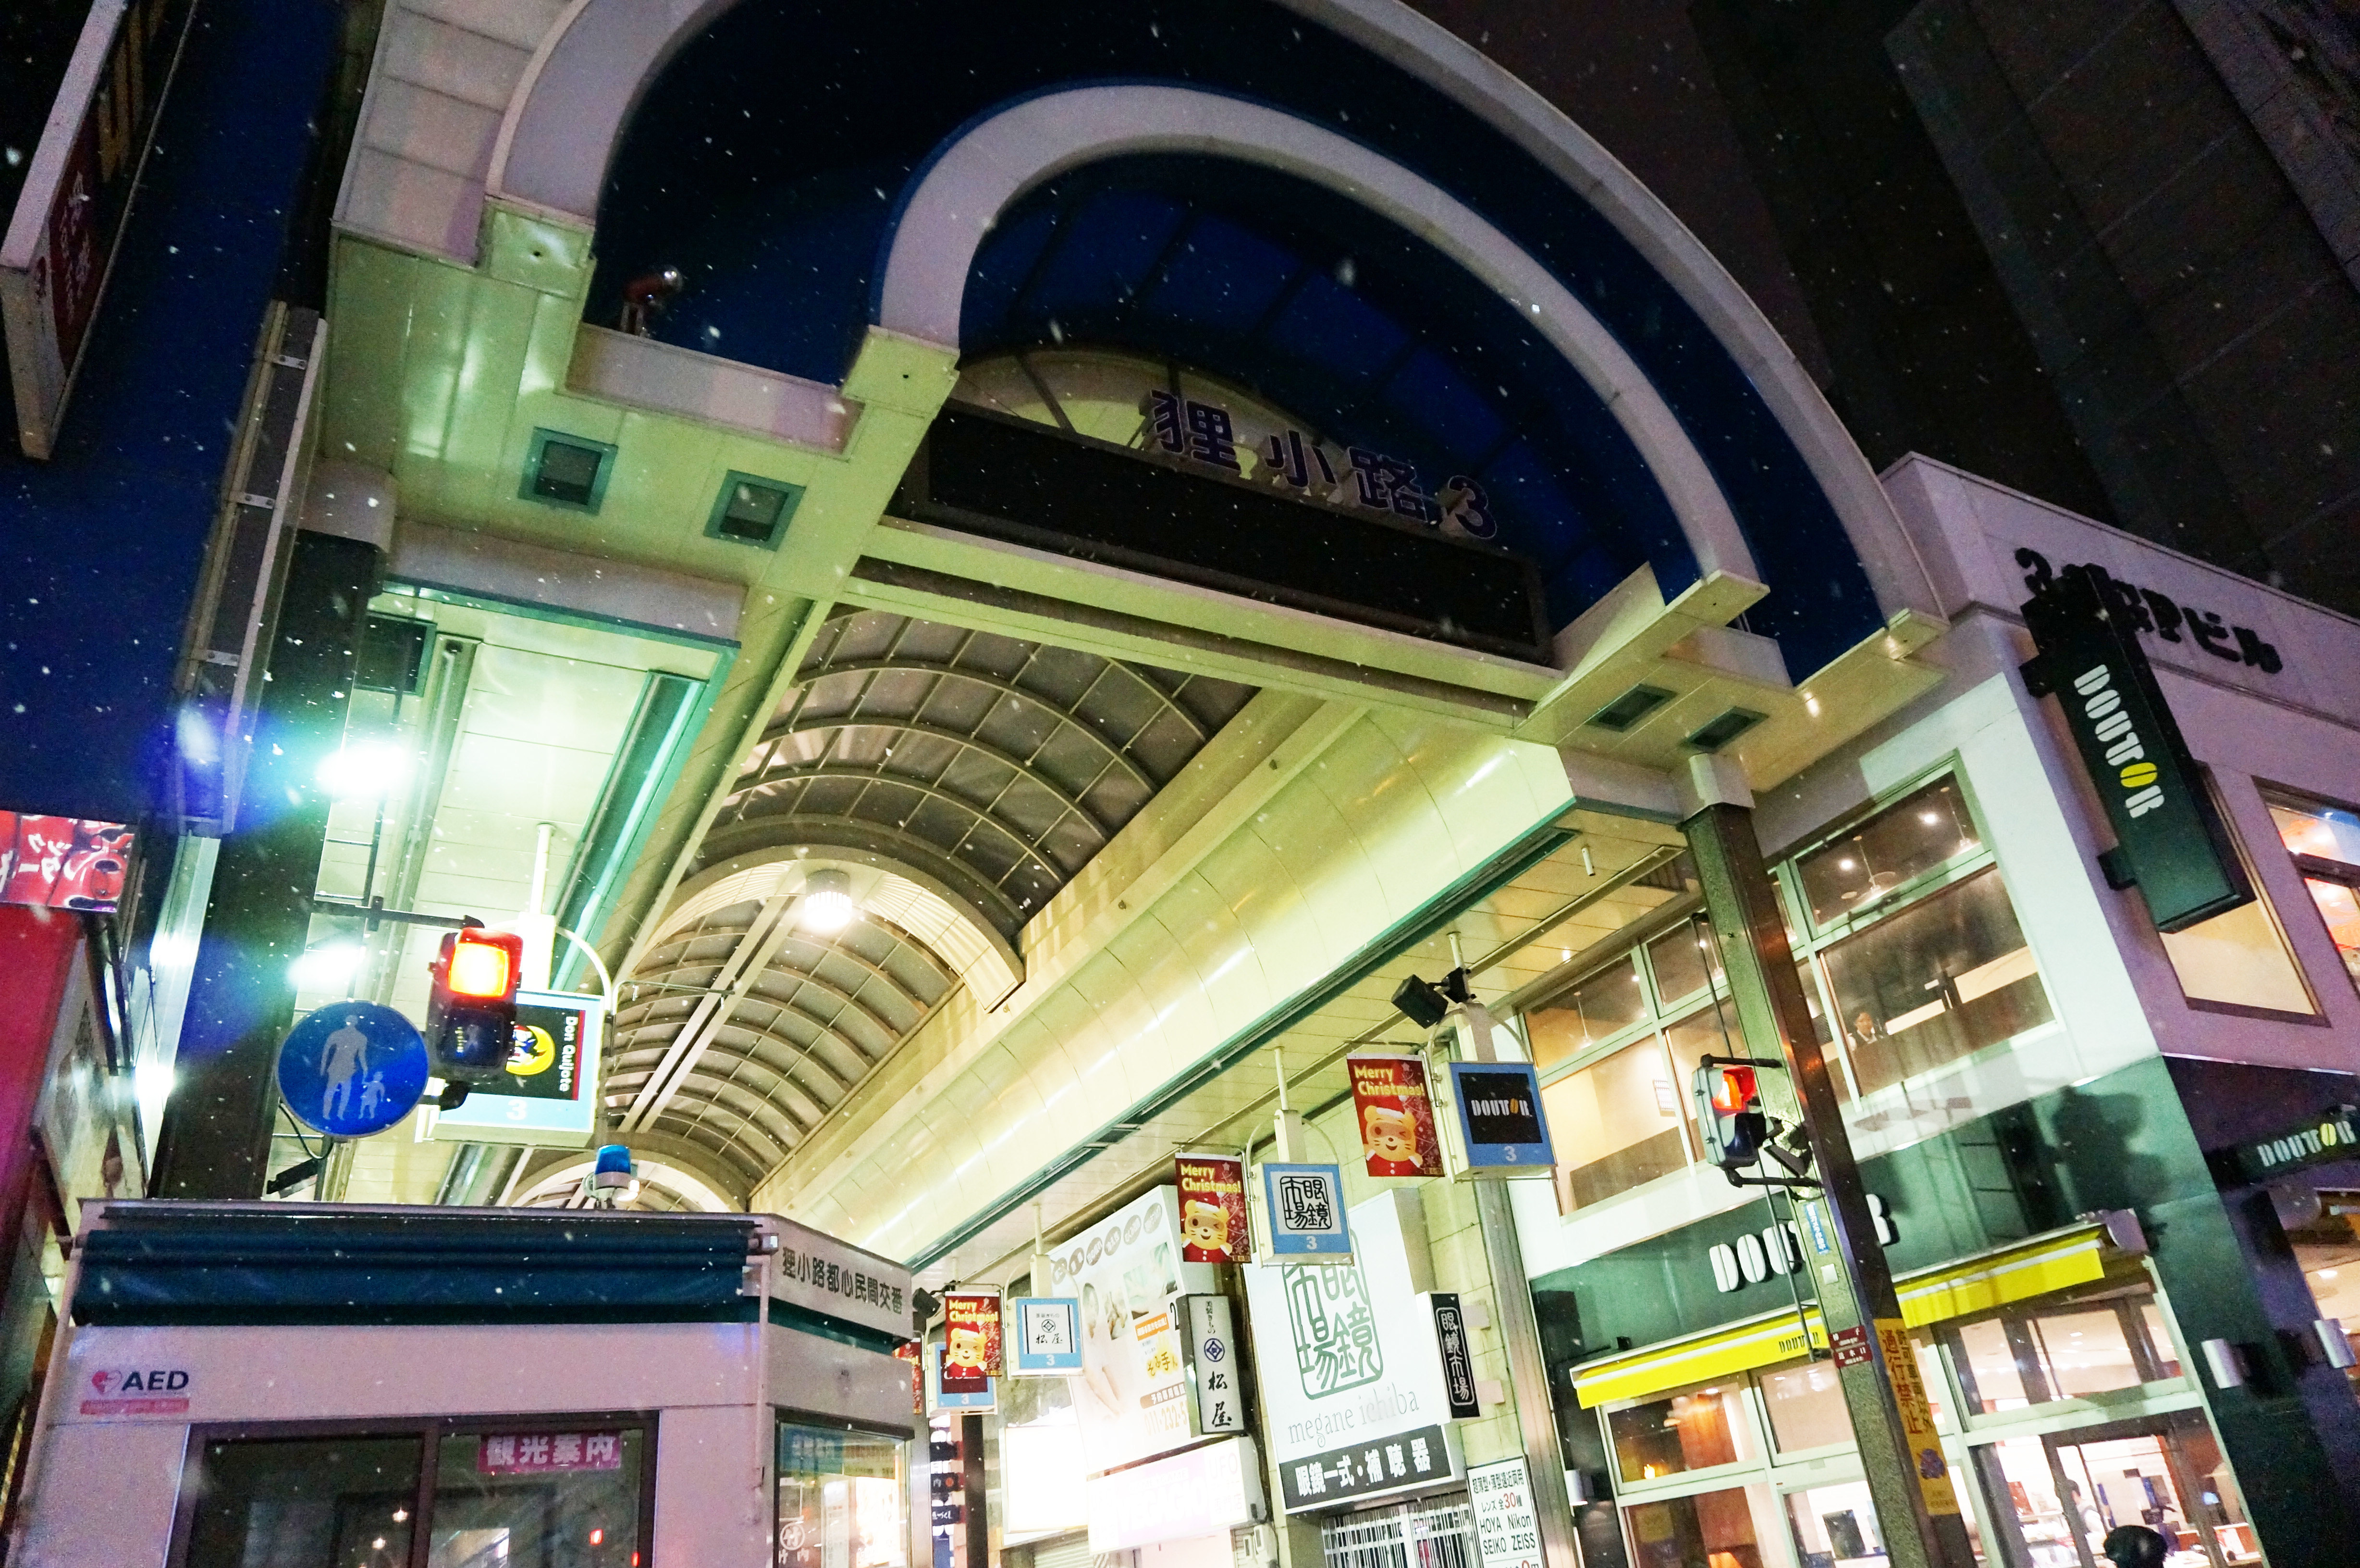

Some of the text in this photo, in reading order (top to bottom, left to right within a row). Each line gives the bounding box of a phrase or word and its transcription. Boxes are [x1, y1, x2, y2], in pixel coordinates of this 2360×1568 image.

[2074, 664, 2165, 819] DOUTOR
[559, 1016, 579, 1092] Don Quijote
[1354, 1065, 1393, 1082] Merry
[1358, 1080, 1426, 1097] Christmas!
[506, 1099, 528, 1120] 3
[1471, 1098, 1530, 1116] DOUTOR
[1504, 1145, 1517, 1162] 3
[2257, 1120, 2357, 1167] DOUTOR
[1180, 1164, 1215, 1179] Merry
[1181, 1177, 1241, 1193] Christmas!
[1306, 1235, 1318, 1250] 3
[783, 1246, 903, 1315] 狸小路都心民間交番
[948, 1299, 978, 1312] Merry
[949, 1310, 999, 1323] Christmas!
[1779, 1332, 1819, 1353] DOUTR
[1046, 1354, 1055, 1366] 3
[1441, 1312, 1469, 1400] 眼鏡市場
[121, 1371, 189, 1391] AED
[961, 1395, 970, 1406] 3
[1208, 1371, 1232, 1428] 松屋
[1289, 1382, 1420, 1448] megane ichiba
[486, 1433, 615, 1467] 観光案内
[1479, 1513, 1532, 1535] HOYA Nikon
[1483, 1532, 1536, 1555] SEIKO ZEISS
